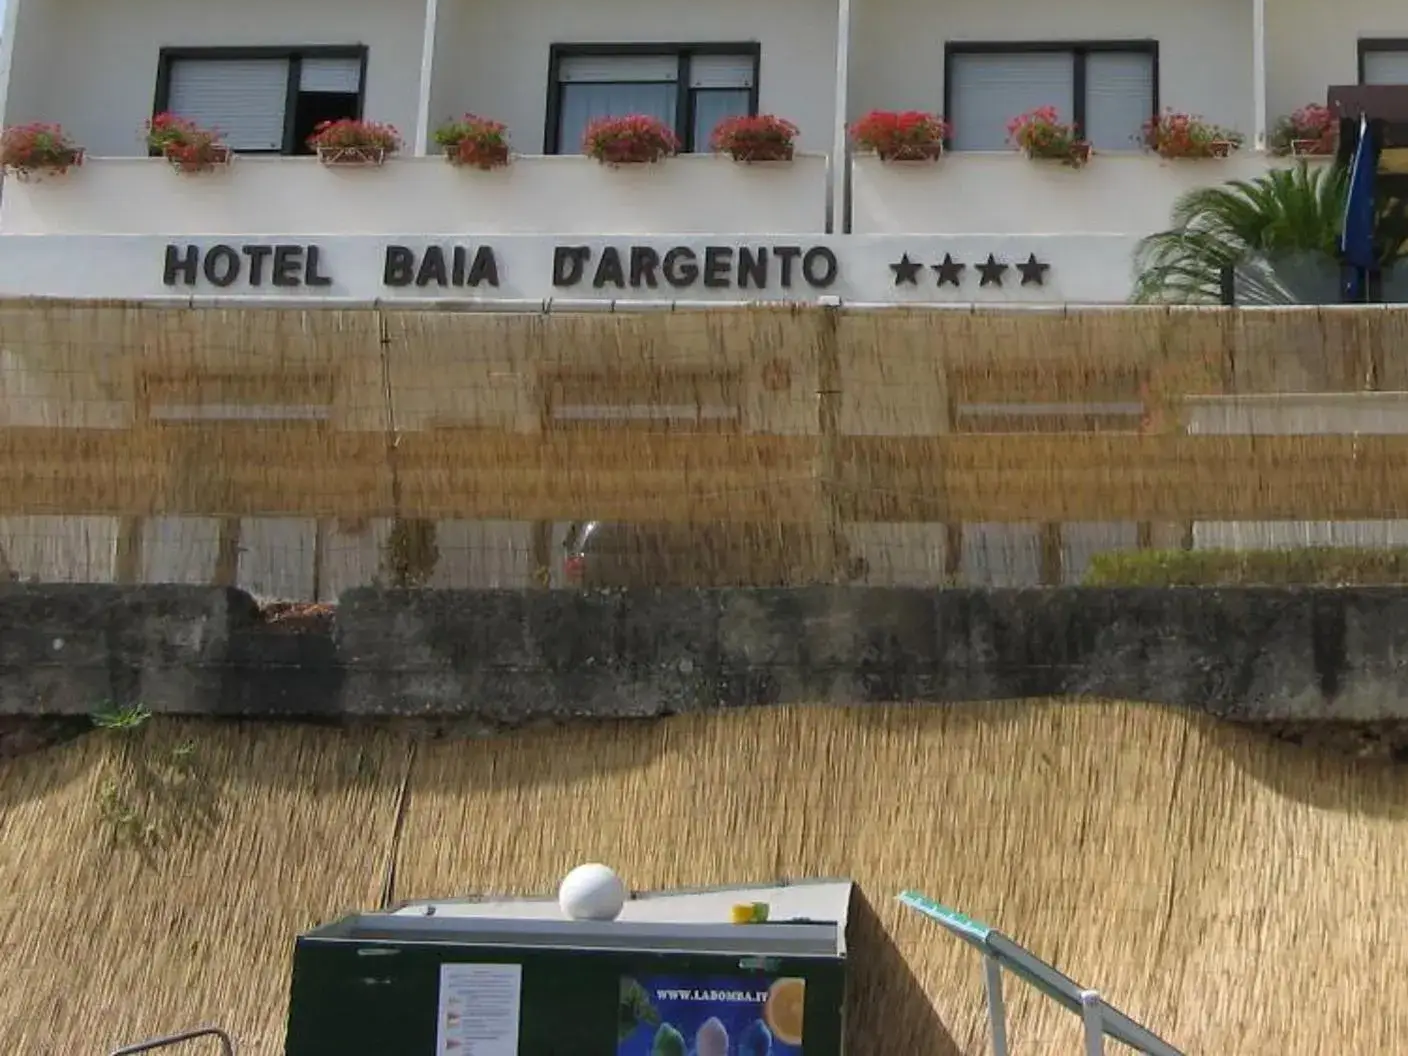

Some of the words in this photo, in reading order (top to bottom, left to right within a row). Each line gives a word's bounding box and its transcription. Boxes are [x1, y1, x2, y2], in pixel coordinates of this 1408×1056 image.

[163, 244, 333, 287] HOTEL
[383, 245, 499, 287] BAIA
[552, 245, 838, 289] D'ARGENTO
[656, 989, 768, 1002] WWW.LABOMBA.IT
